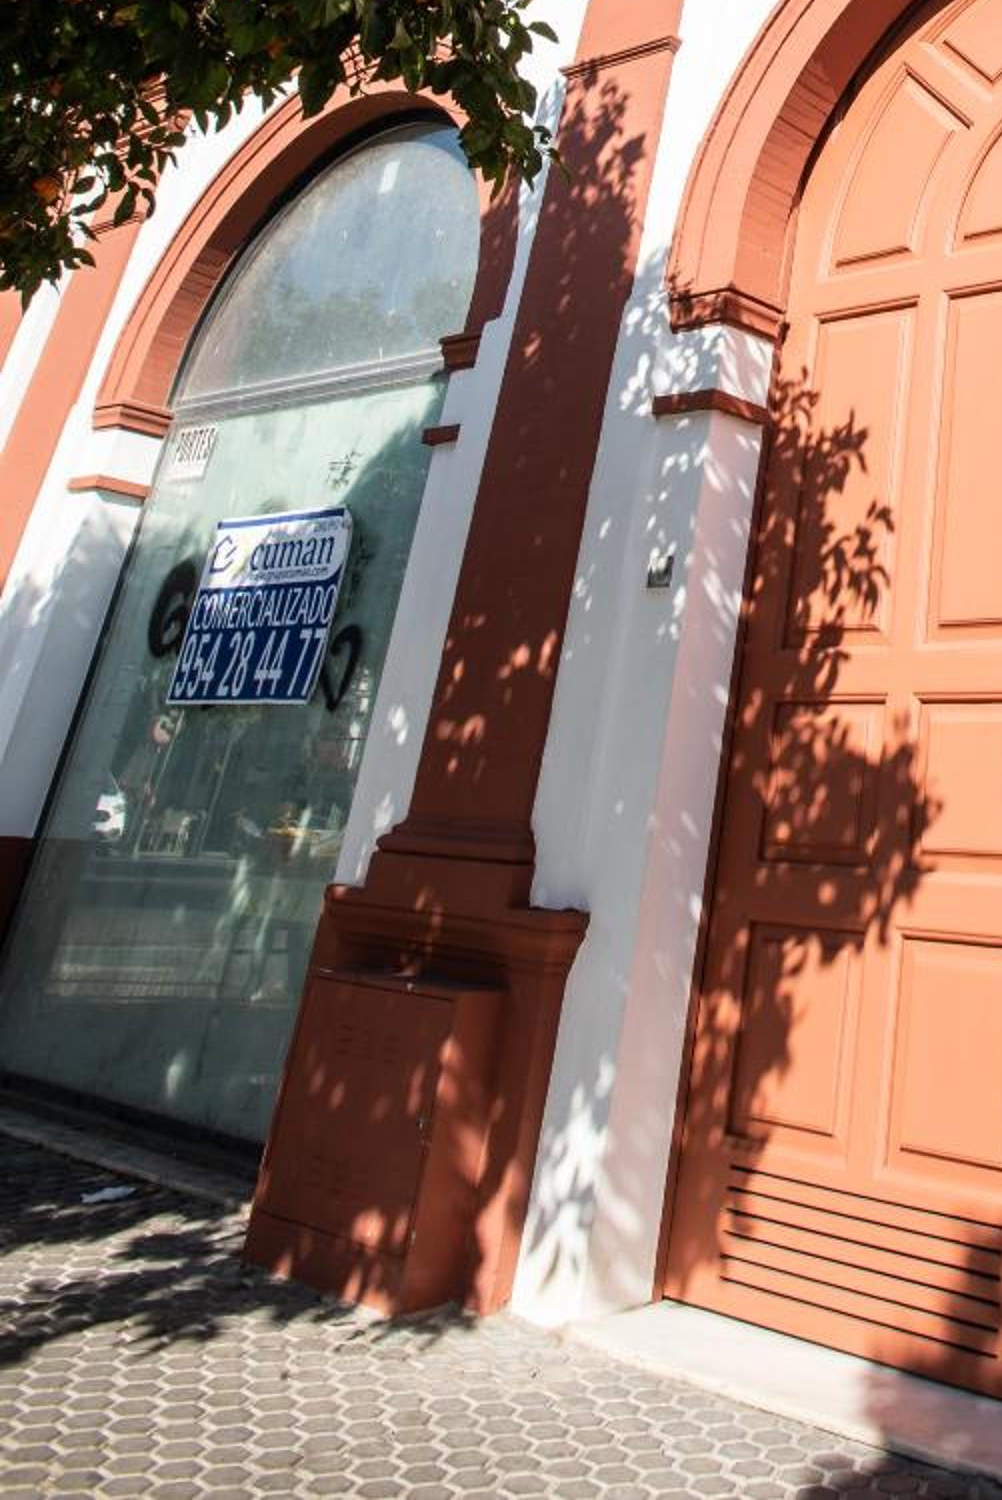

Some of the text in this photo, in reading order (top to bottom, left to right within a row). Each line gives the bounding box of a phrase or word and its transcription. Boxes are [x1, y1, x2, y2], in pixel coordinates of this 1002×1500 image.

[250, 535, 335, 572] cuman
[193, 585, 336, 630] COMERCIALIZADO
[173, 631, 224, 699] 954
[216, 630, 256, 698] 28
[254, 629, 291, 698] 44
[287, 627, 328, 697] 77
